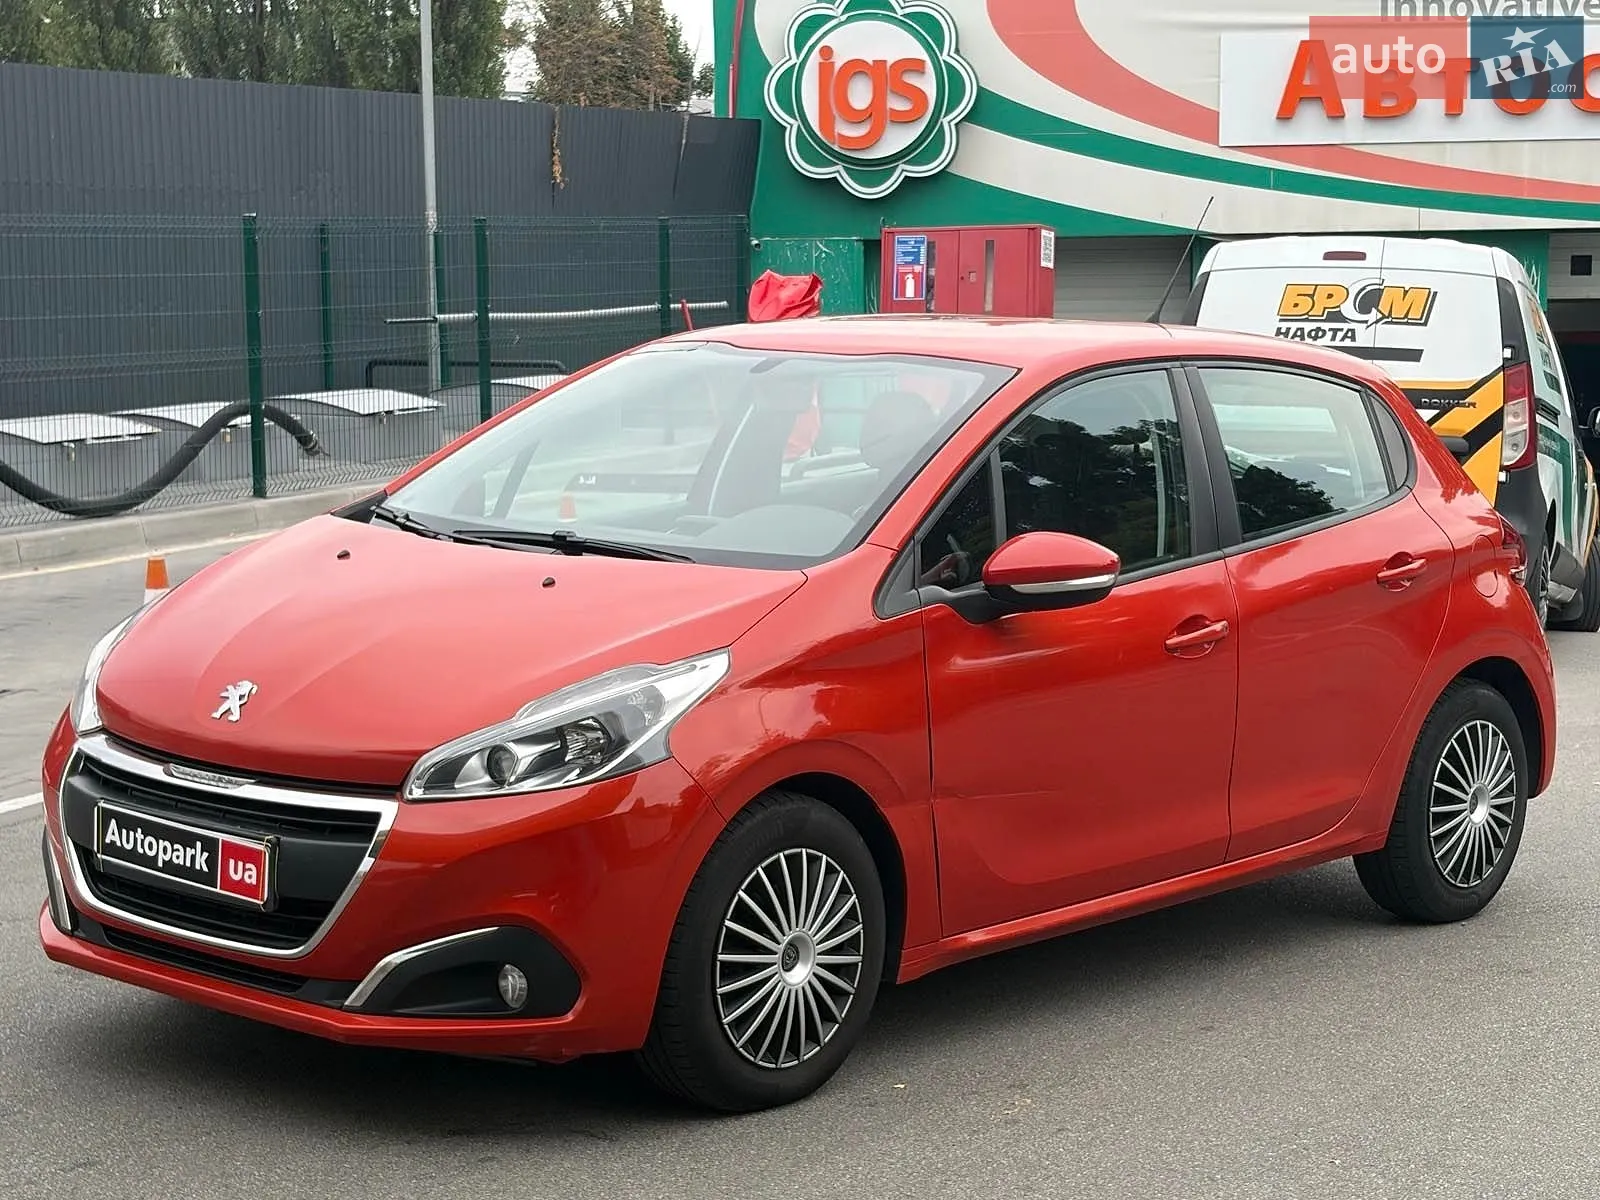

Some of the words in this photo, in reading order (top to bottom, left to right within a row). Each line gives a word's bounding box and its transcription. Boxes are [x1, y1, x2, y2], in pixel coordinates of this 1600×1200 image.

[1275, 326, 1357, 343] НАФТА
[1421, 398, 1477, 409] DOKKER
[105, 818, 209, 873] Autopark
[228, 857, 258, 886] ua
